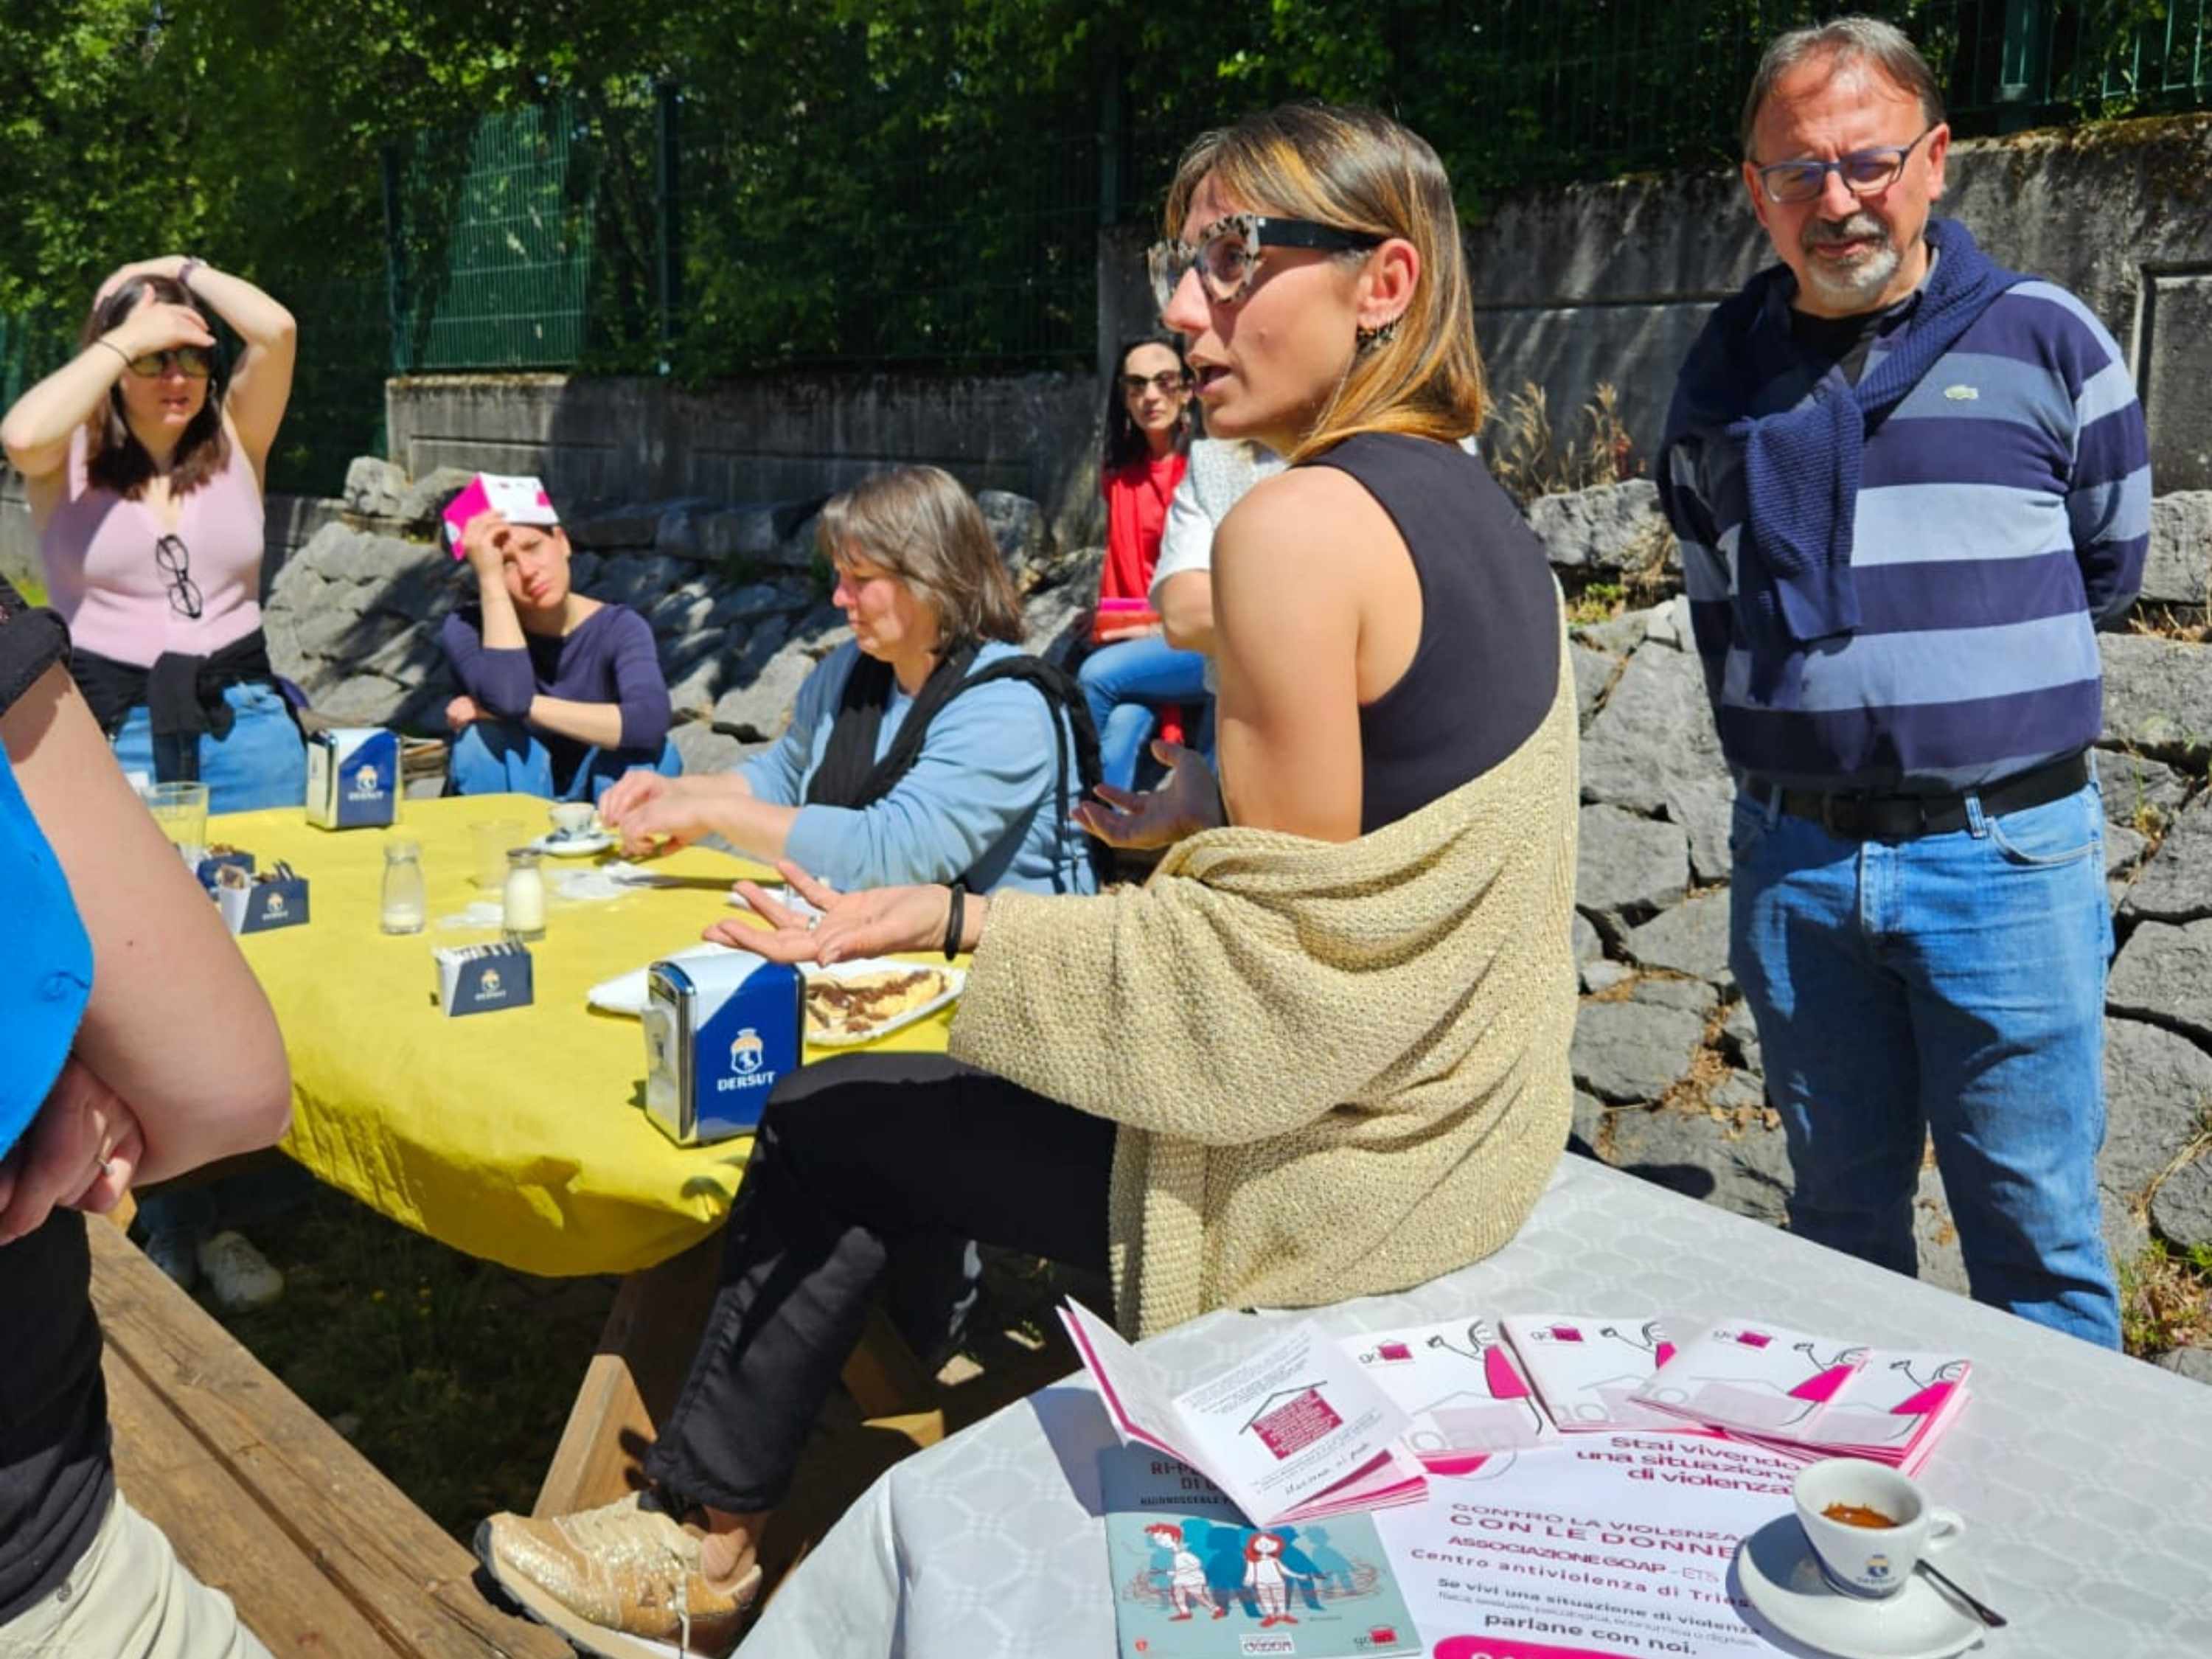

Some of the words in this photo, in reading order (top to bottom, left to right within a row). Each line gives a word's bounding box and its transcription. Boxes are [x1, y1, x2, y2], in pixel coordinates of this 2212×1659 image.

[717, 1071, 776, 1092] DERSUT
[1577, 1451, 1632, 1464] una
[1611, 1437, 1673, 1451] Stai
[1680, 1443, 1799, 1471] vivendo
[1627, 1468, 1654, 1481] di
[1661, 1473, 1794, 1495] violenza
[1450, 1514, 1531, 1533] CON
[1546, 1526, 1587, 1541] LE
[1601, 1532, 1735, 1559] DONNE
[1452, 1503, 1563, 1523] CONTRO
[1571, 1517, 1601, 1528] LA
[1609, 1521, 1738, 1541] VIOLENZA
[1448, 1536, 1601, 1565] ASSOCIAZIONE
[1602, 1557, 1666, 1573] GOAP
[1411, 1548, 1488, 1568] Centro
[1499, 1562, 1646, 1593] antiviolenza
[1658, 1585, 1678, 1597] di
[1688, 1589, 1750, 1608] Tries
[1438, 1578, 1460, 1588] Se
[1467, 1582, 1498, 1595] vivi
[1506, 1590, 1540, 1601] una
[1546, 1595, 1646, 1617] situazione
[1653, 1611, 1672, 1621] di
[1484, 1613, 1583, 1636] parlane
[1592, 1630, 1640, 1646] con
[1649, 1638, 1697, 1655] noi.
